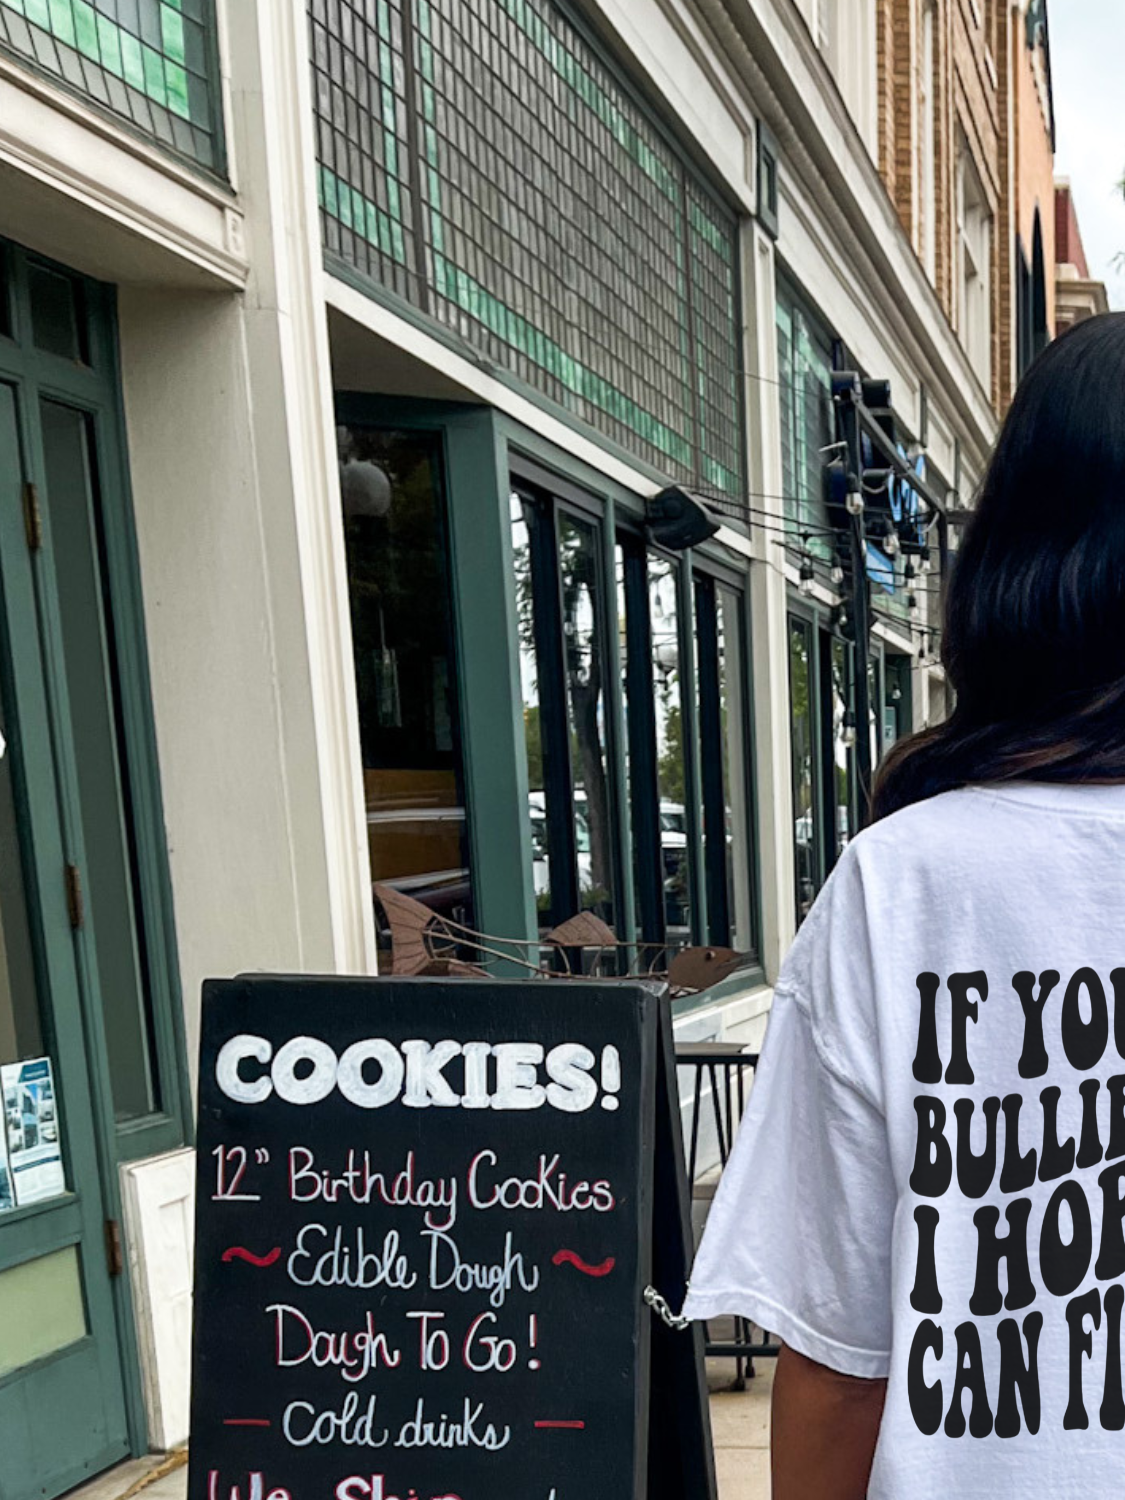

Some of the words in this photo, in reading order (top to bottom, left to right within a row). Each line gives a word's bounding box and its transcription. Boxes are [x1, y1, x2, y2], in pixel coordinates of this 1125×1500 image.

[912, 970, 988, 1084] IF
[215, 1034, 621, 1112] COOKIES!
[289, 1146, 458, 1230] Birthday
[287, 1223, 416, 1289] Edible
[421, 1230, 539, 1308] Dough
[909, 1204, 943, 1314] I
[266, 1305, 400, 1381] Dough
[407, 1312, 449, 1368] To
[907, 1310, 1044, 1438] CAN
[283, 1391, 388, 1448] Cold
